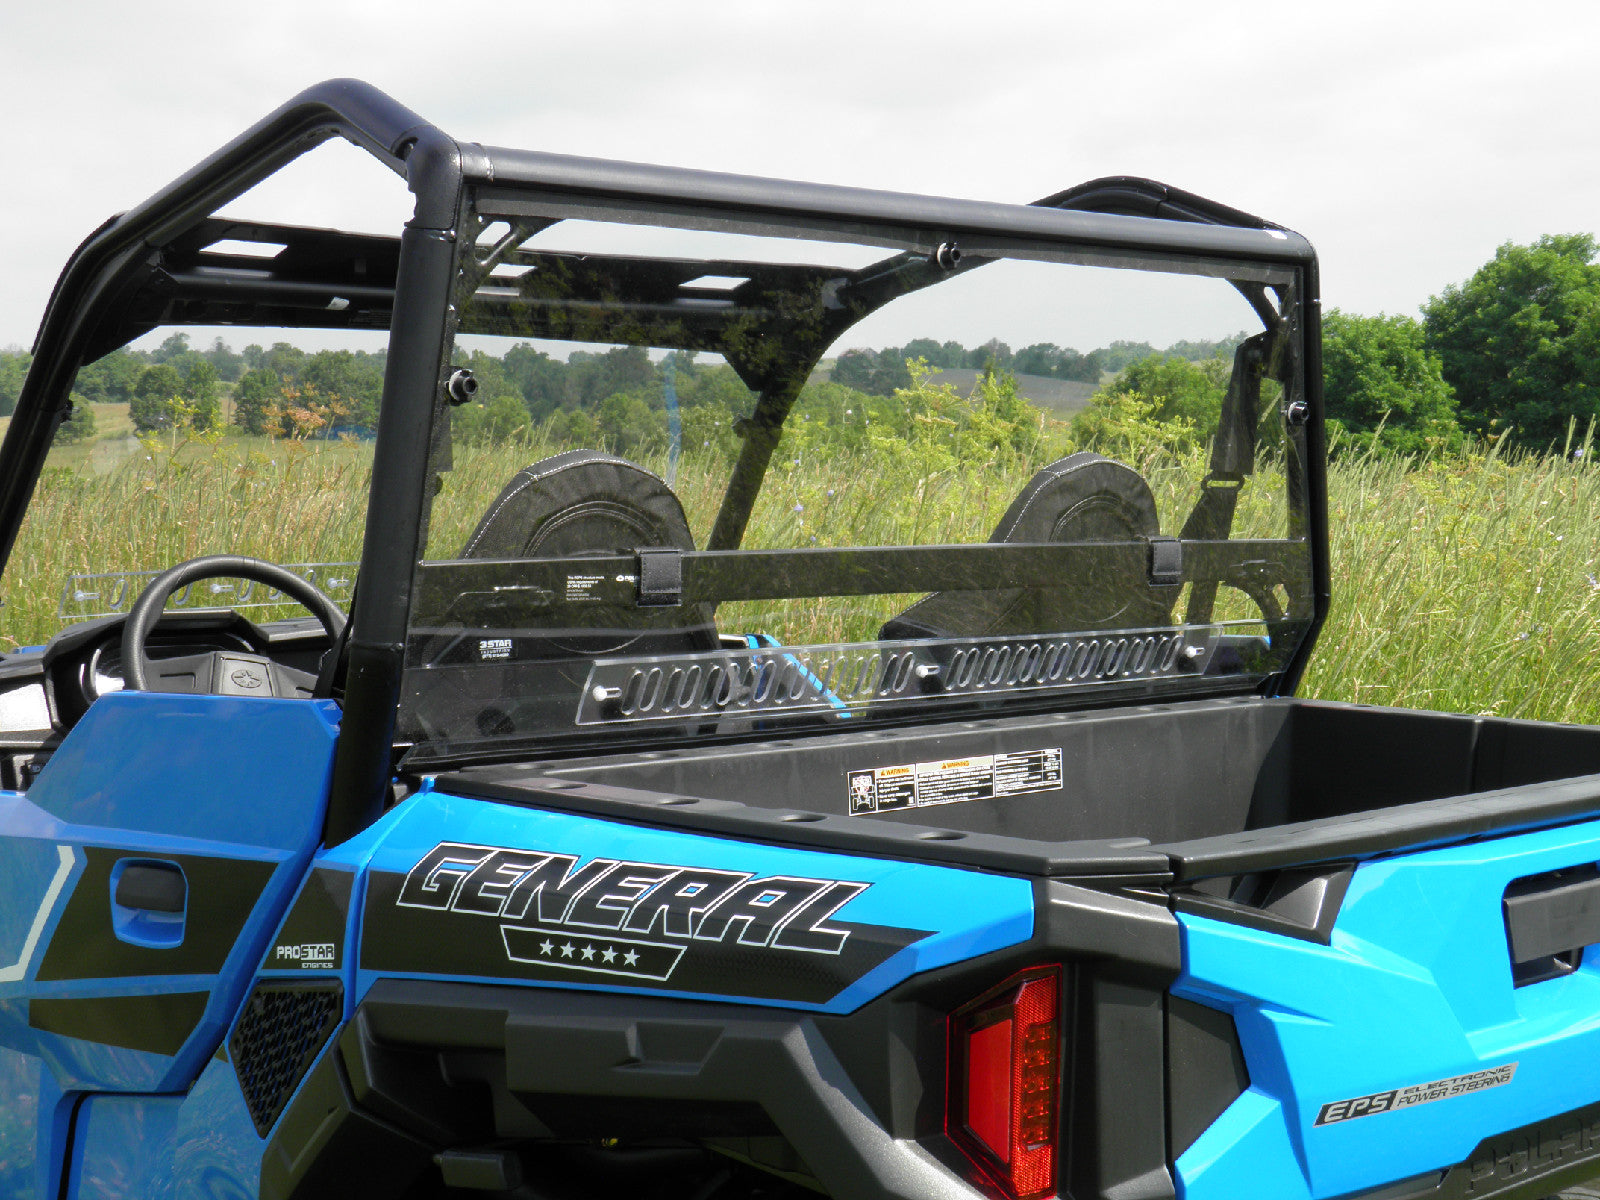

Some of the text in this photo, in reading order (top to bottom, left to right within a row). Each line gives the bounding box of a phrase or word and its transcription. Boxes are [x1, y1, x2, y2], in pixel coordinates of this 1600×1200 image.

[886, 767, 910, 776] WARNING
[395, 840, 876, 955] GENERAL
[276, 944, 334, 960] PROSTAR
[1397, 1072, 1512, 1106] POWER STEERING
[1403, 1065, 1512, 1095] ELECTRONIC
[1324, 1092, 1393, 1122] EPS
